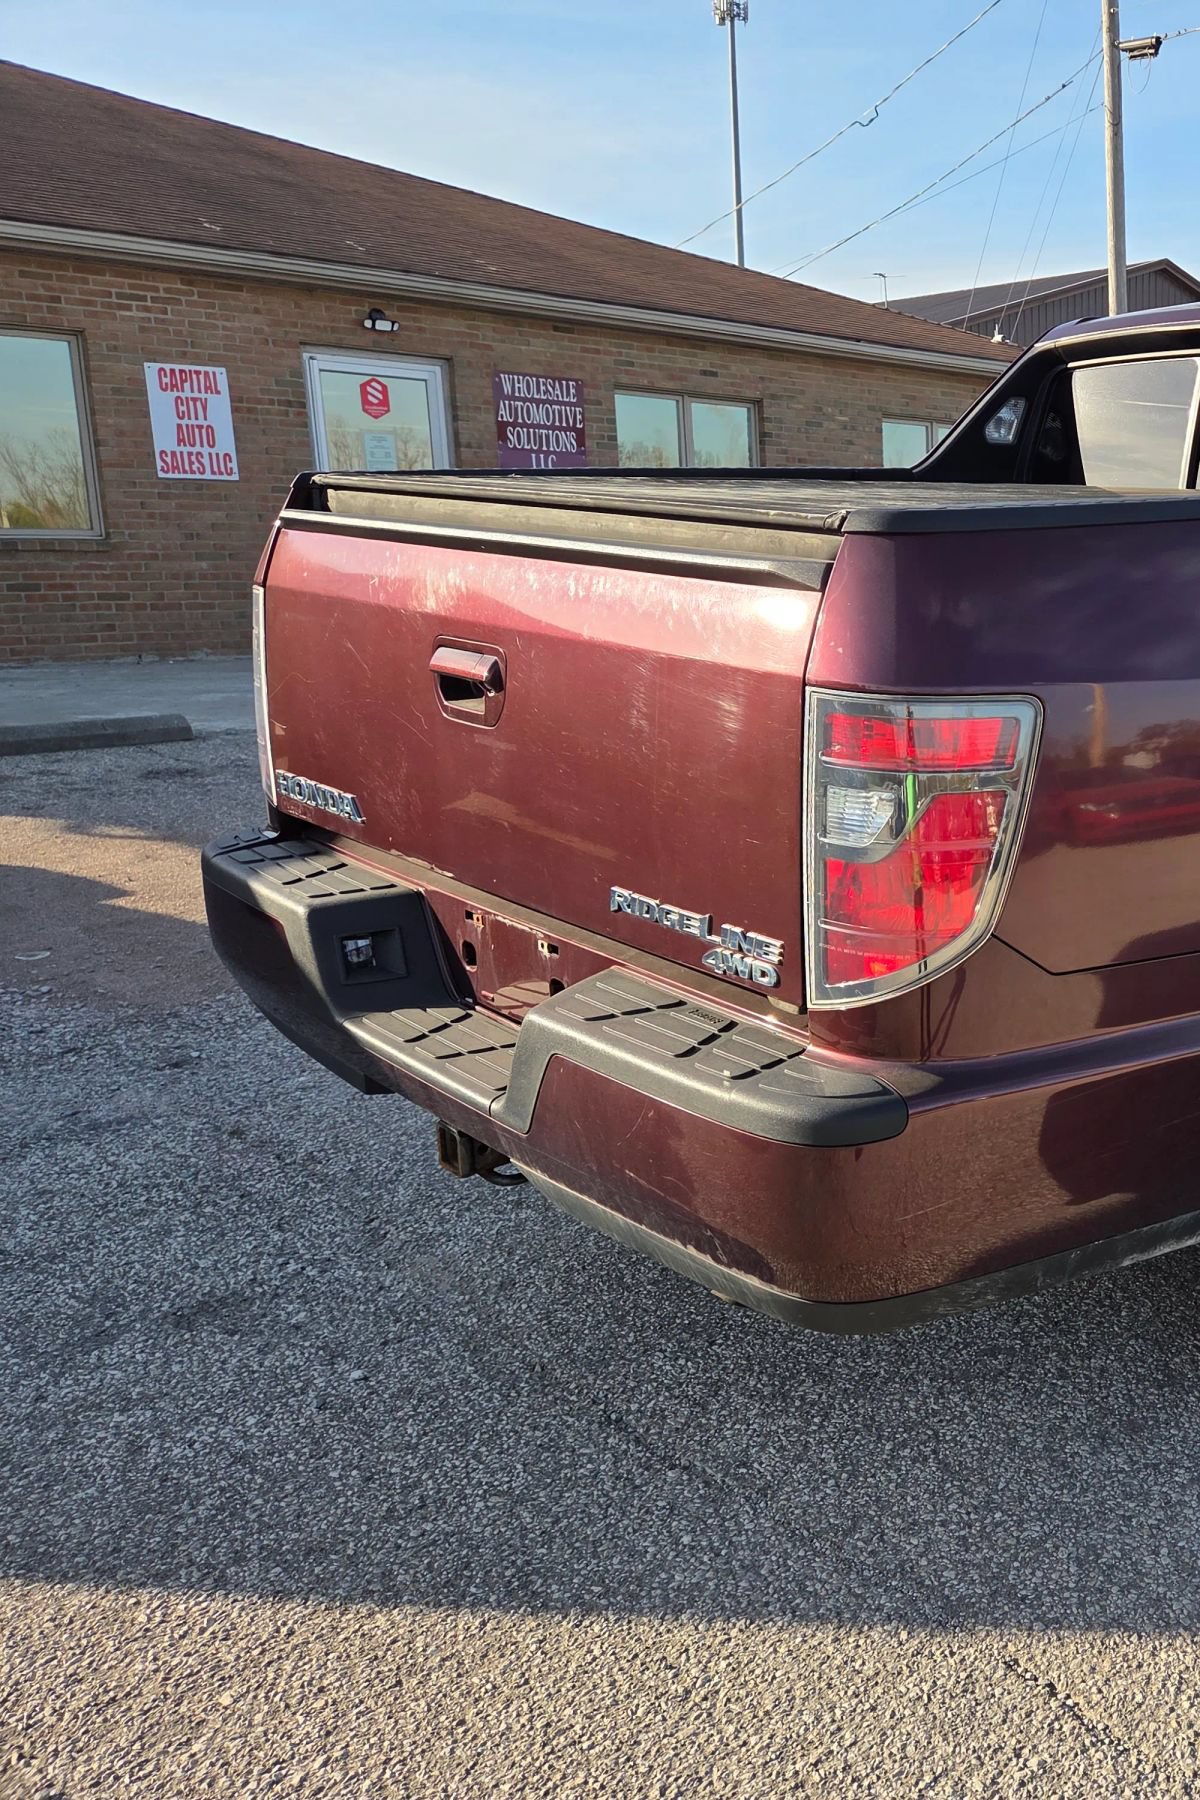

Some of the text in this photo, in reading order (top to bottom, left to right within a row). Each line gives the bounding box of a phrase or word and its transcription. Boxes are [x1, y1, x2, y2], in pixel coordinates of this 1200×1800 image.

[158, 367, 221, 395] CAPITAL
[500, 373, 577, 402] WHOLESALE
[174, 395, 208, 421] CITY
[497, 400, 583, 428] AUTOMOTIVE
[176, 423, 216, 448] AUTO
[506, 426, 577, 453] SOLUTIONS
[159, 449, 234, 476] SALES LLC
[275, 769, 366, 823] HONDA
[610, 886, 785, 965] RIDGELINE
[702, 948, 780, 987] 4WD
